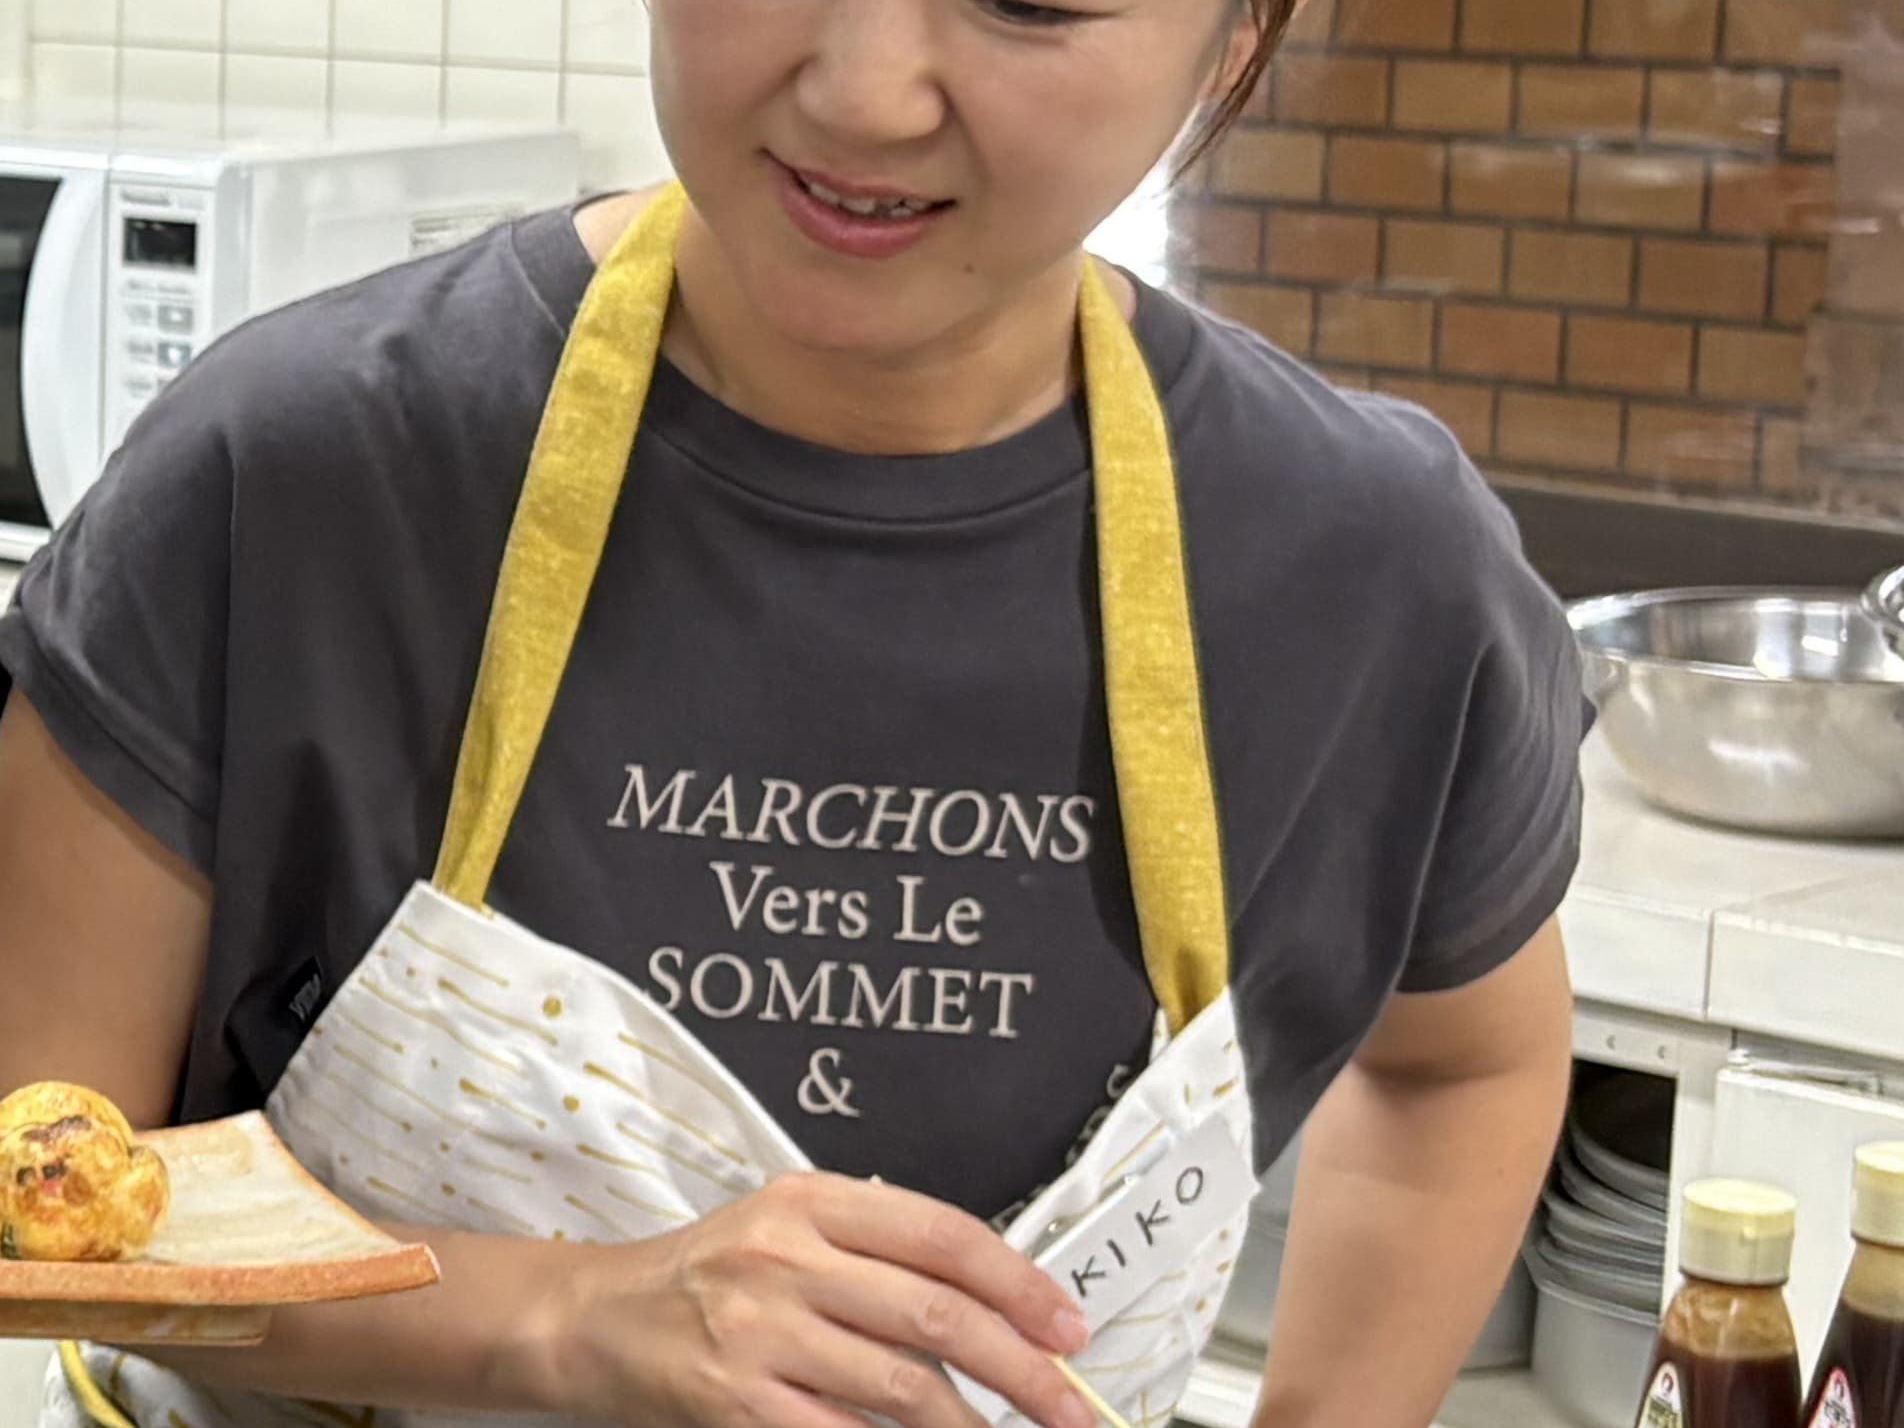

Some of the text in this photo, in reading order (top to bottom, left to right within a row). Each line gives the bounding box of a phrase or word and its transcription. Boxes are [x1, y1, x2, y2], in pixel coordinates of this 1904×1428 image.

[606, 763, 1095, 863] MARCHONS
[709, 861, 984, 946] Vers Le
[647, 945, 1035, 1039] SOMMET
[796, 1046, 860, 1118] &
